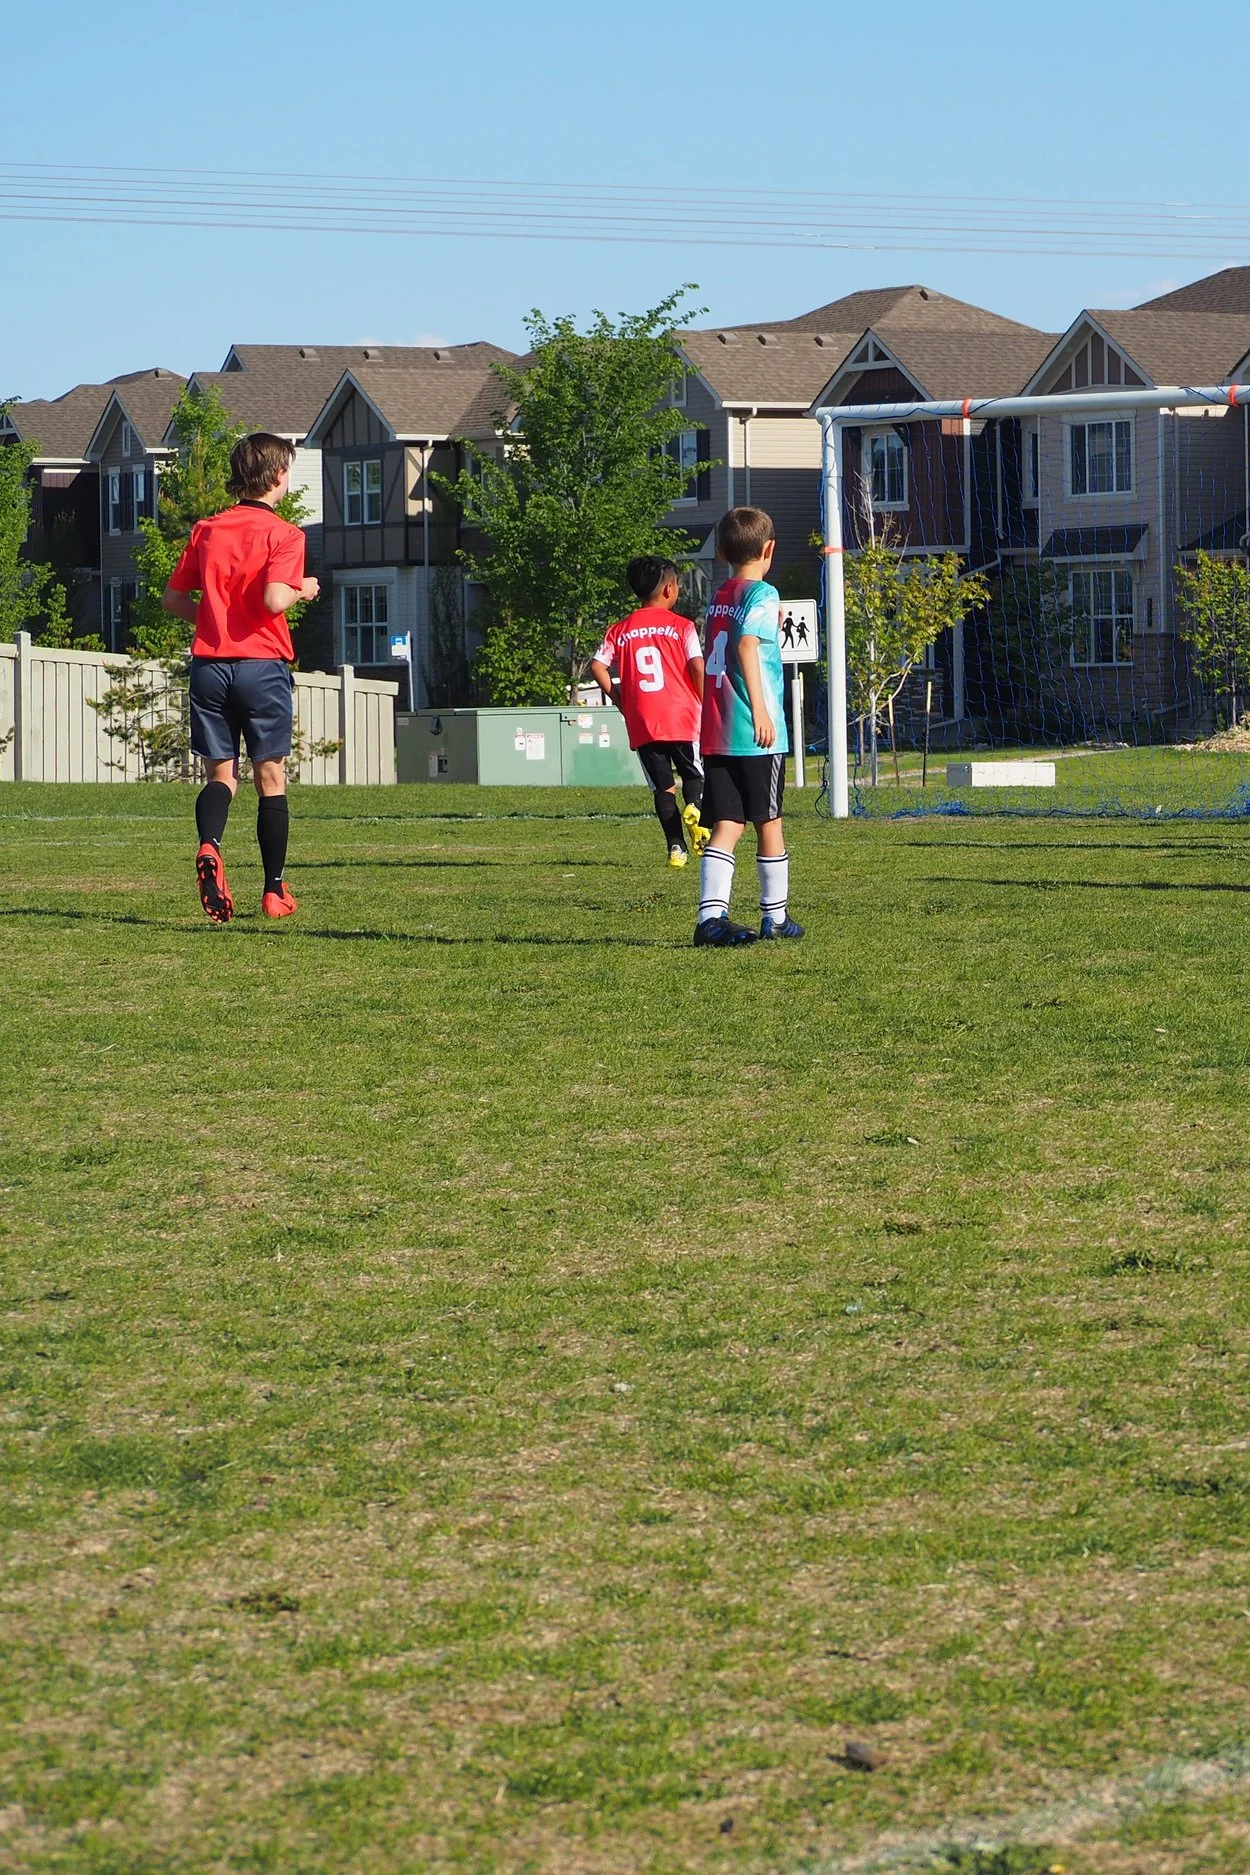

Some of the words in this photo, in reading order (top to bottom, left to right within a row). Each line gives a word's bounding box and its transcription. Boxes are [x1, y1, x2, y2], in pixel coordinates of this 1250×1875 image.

[706, 604, 745, 625] appelle
[635, 645, 665, 693] 9
[705, 630, 728, 689] 4
